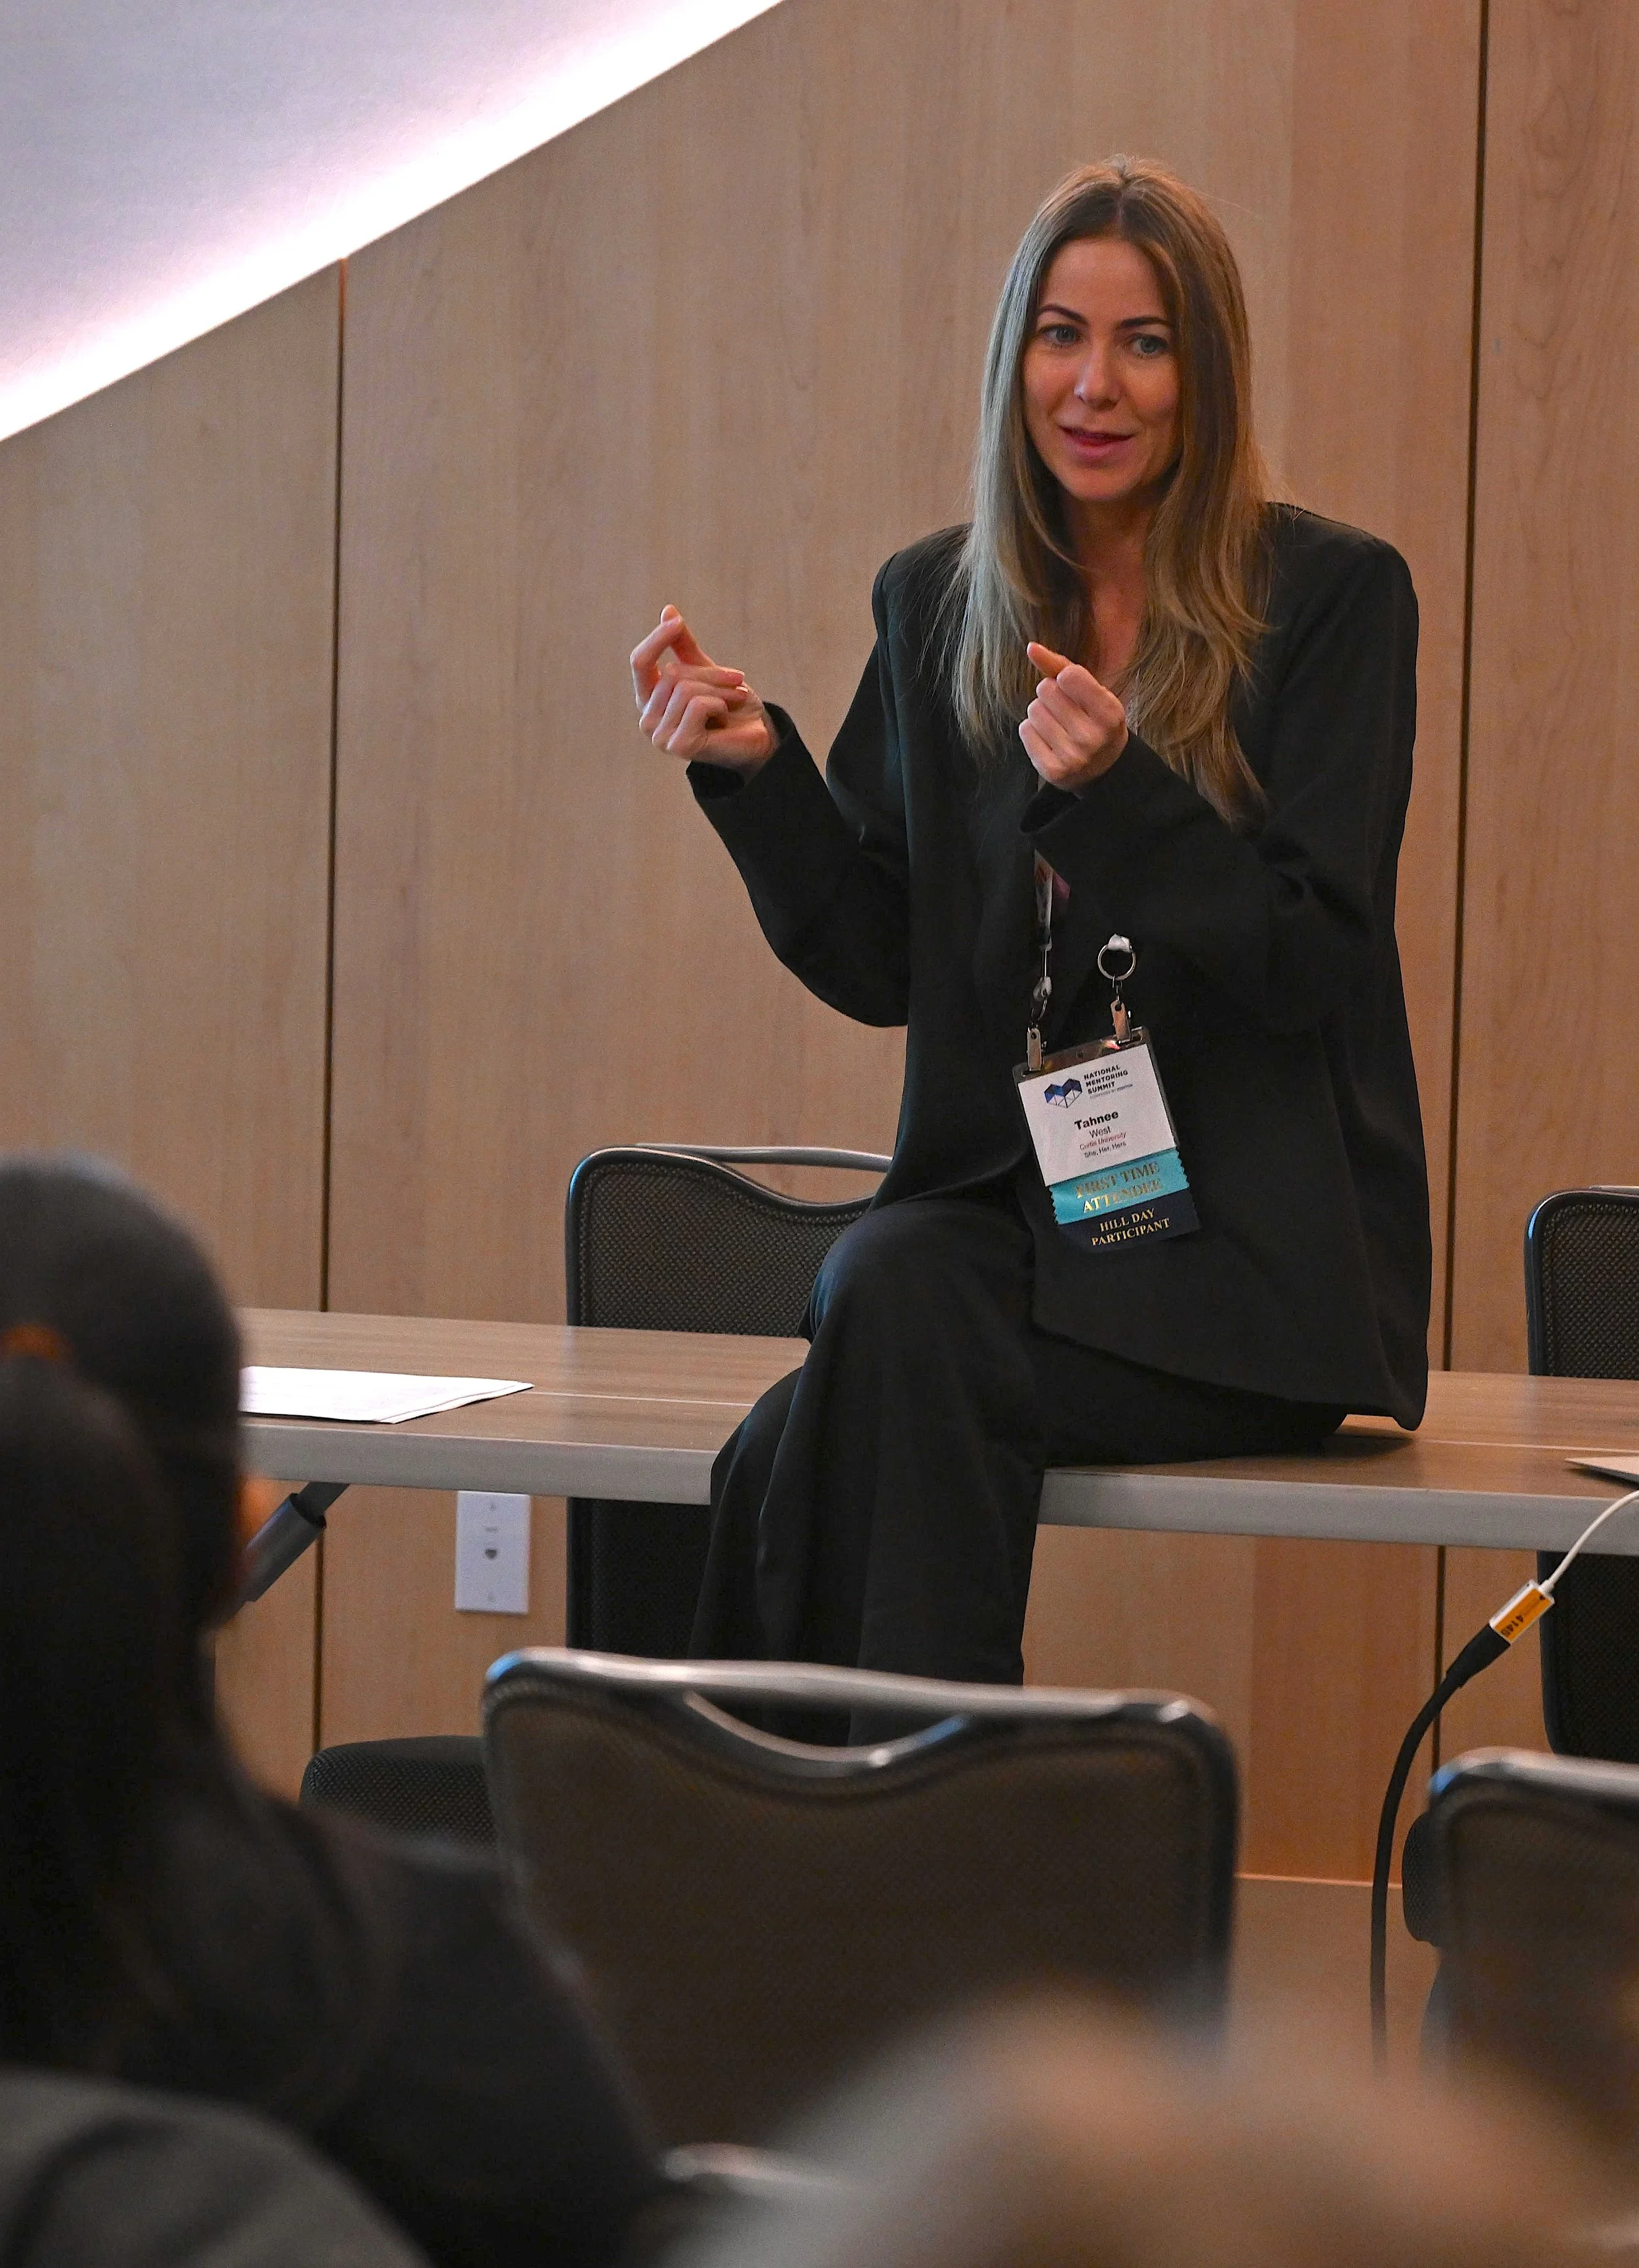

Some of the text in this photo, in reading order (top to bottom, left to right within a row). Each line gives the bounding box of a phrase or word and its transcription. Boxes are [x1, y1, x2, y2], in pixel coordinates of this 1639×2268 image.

[1084, 1065, 1120, 1080] NATIONAL
[1086, 1070, 1128, 1087] MENTORING
[1088, 1081, 1115, 1094] SUMMIT
[1074, 1111, 1119, 1130] Tahnee
[1089, 1125, 1111, 1139] West
[1097, 1132, 1126, 1145] University
[1080, 1141, 1097, 1150] Curtin
[1075, 1162, 1160, 1199] FIRST TIME
[1083, 1179, 1162, 1213] ATTENDEE
[1099, 1208, 1155, 1232] HILL DAY
[1091, 1217, 1170, 1246] PARTICIPANT
